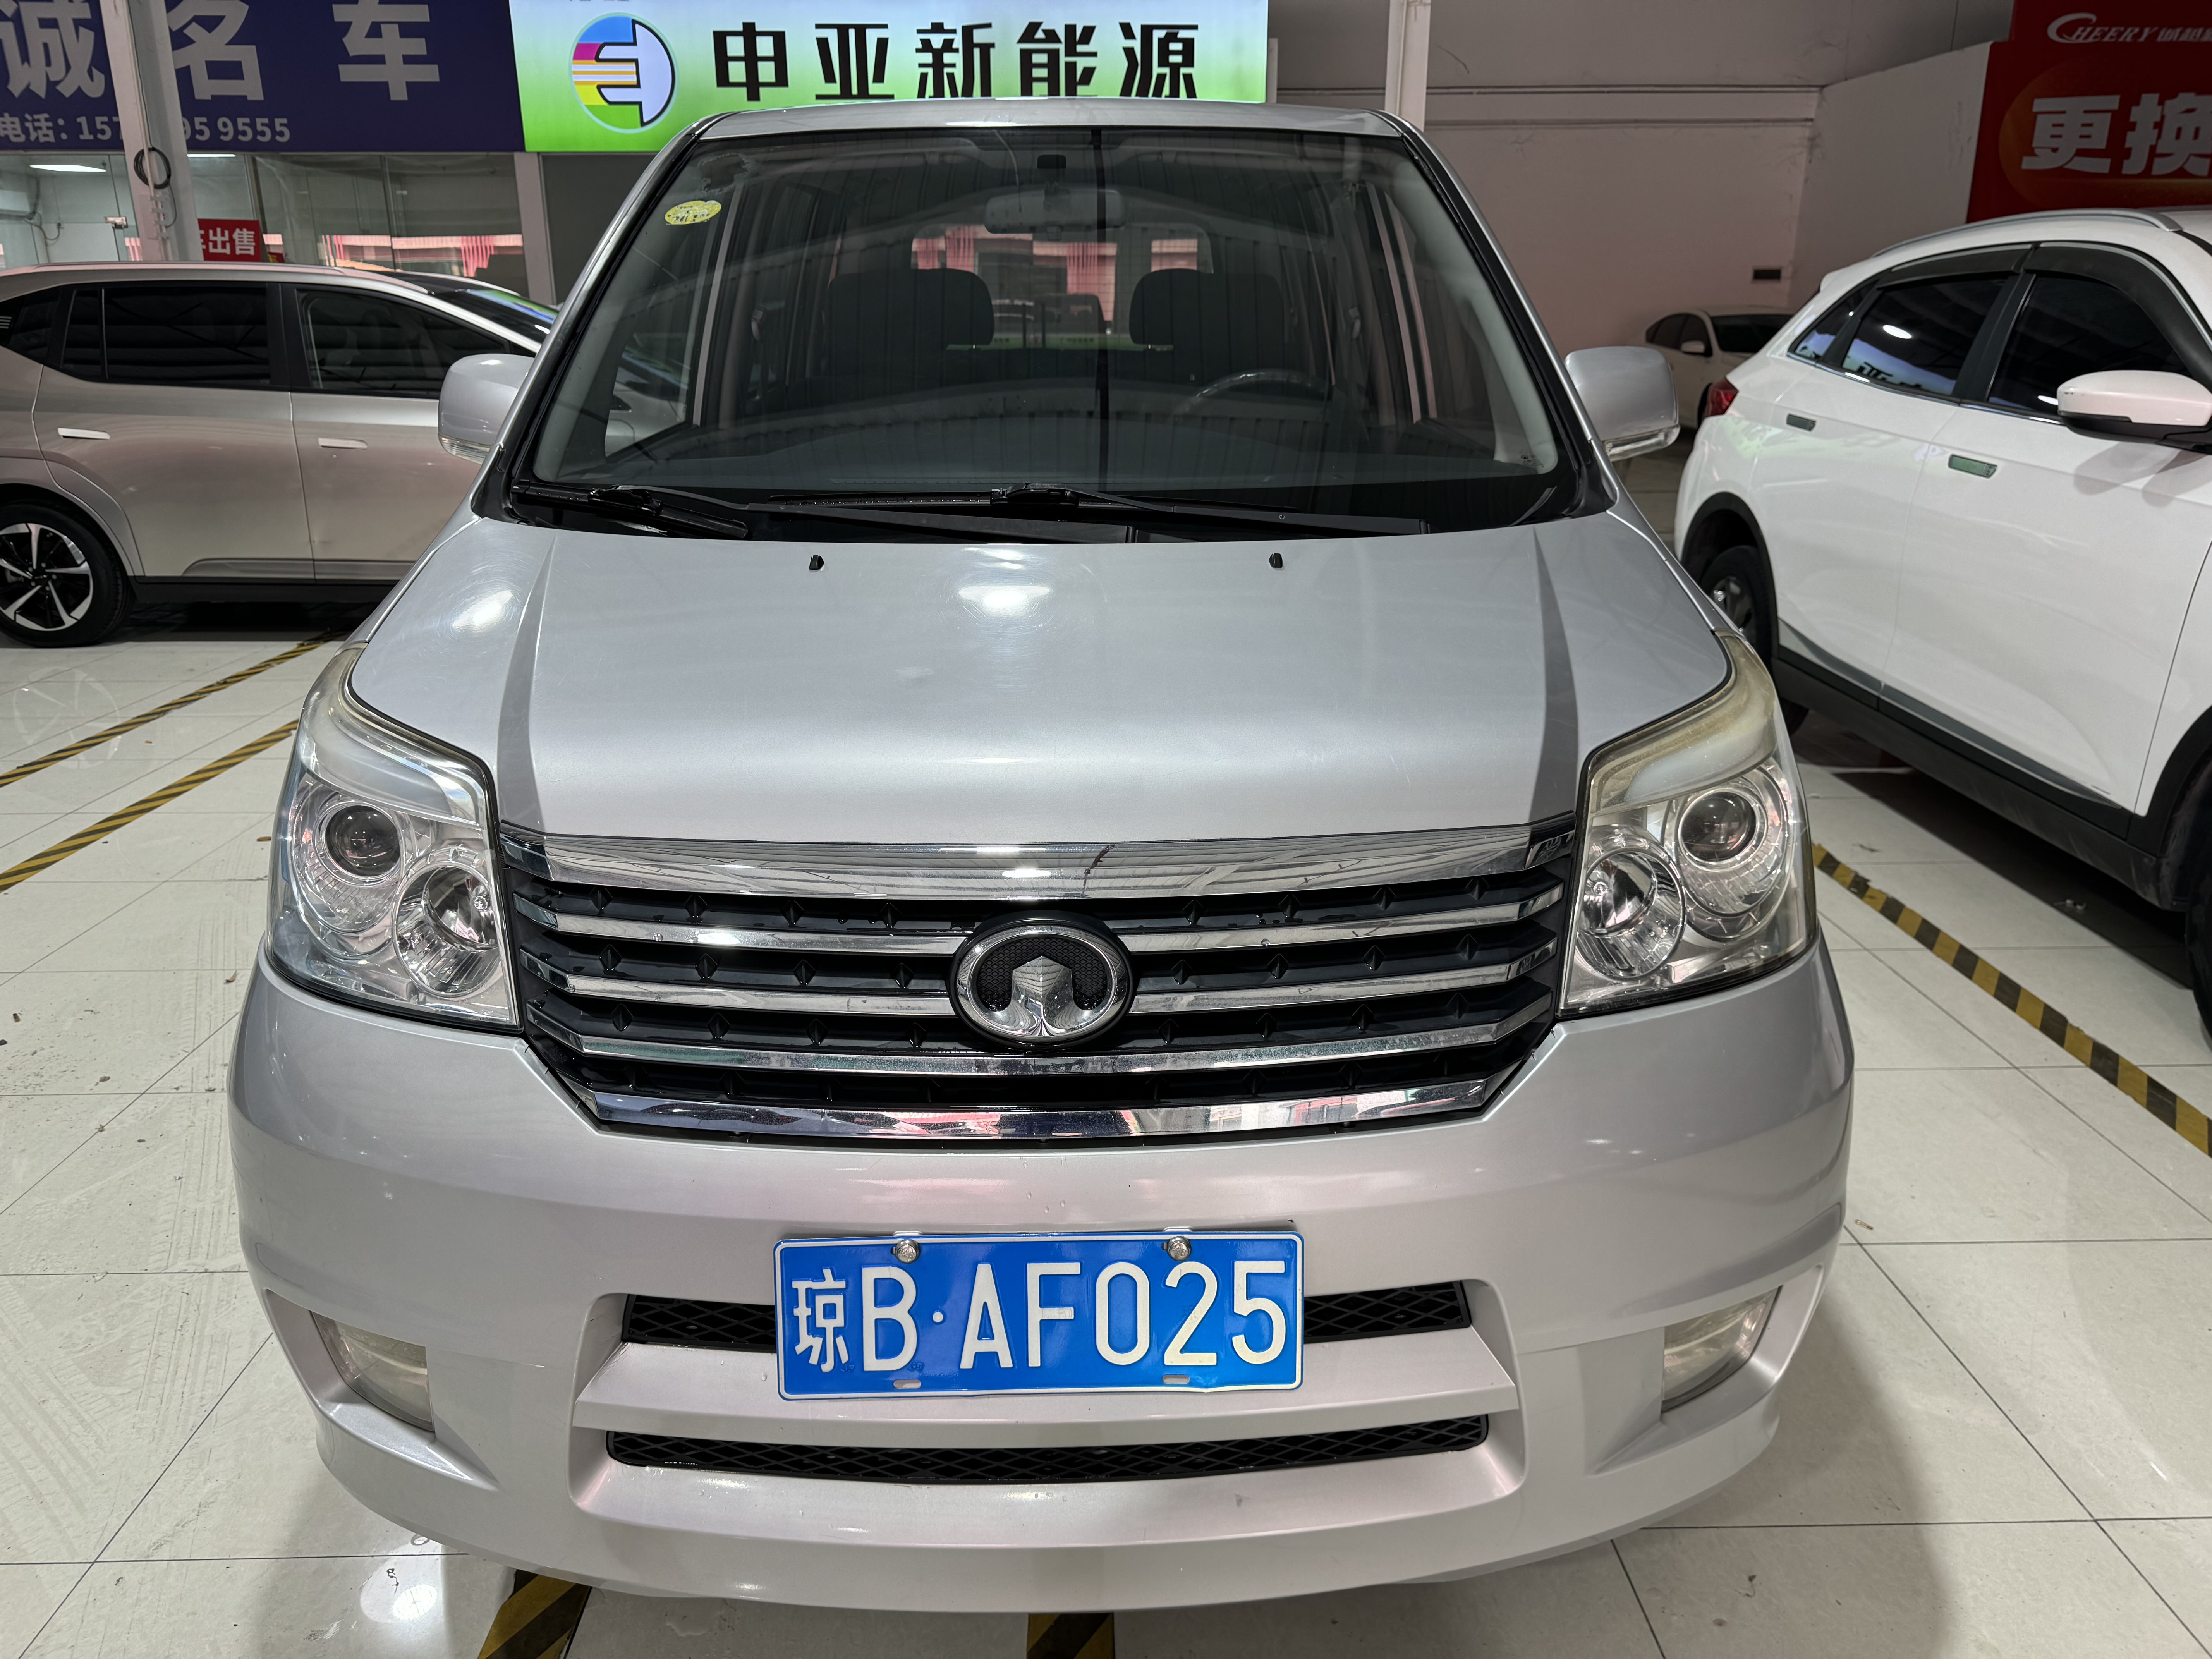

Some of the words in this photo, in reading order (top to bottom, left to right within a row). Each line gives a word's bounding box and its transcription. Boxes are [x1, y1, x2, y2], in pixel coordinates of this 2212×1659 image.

[713, 21, 1198, 101] 申亚新能源
[2021, 92, 2212, 177] 更换
[792, 1261, 1286, 1372] 琼B·AF025
